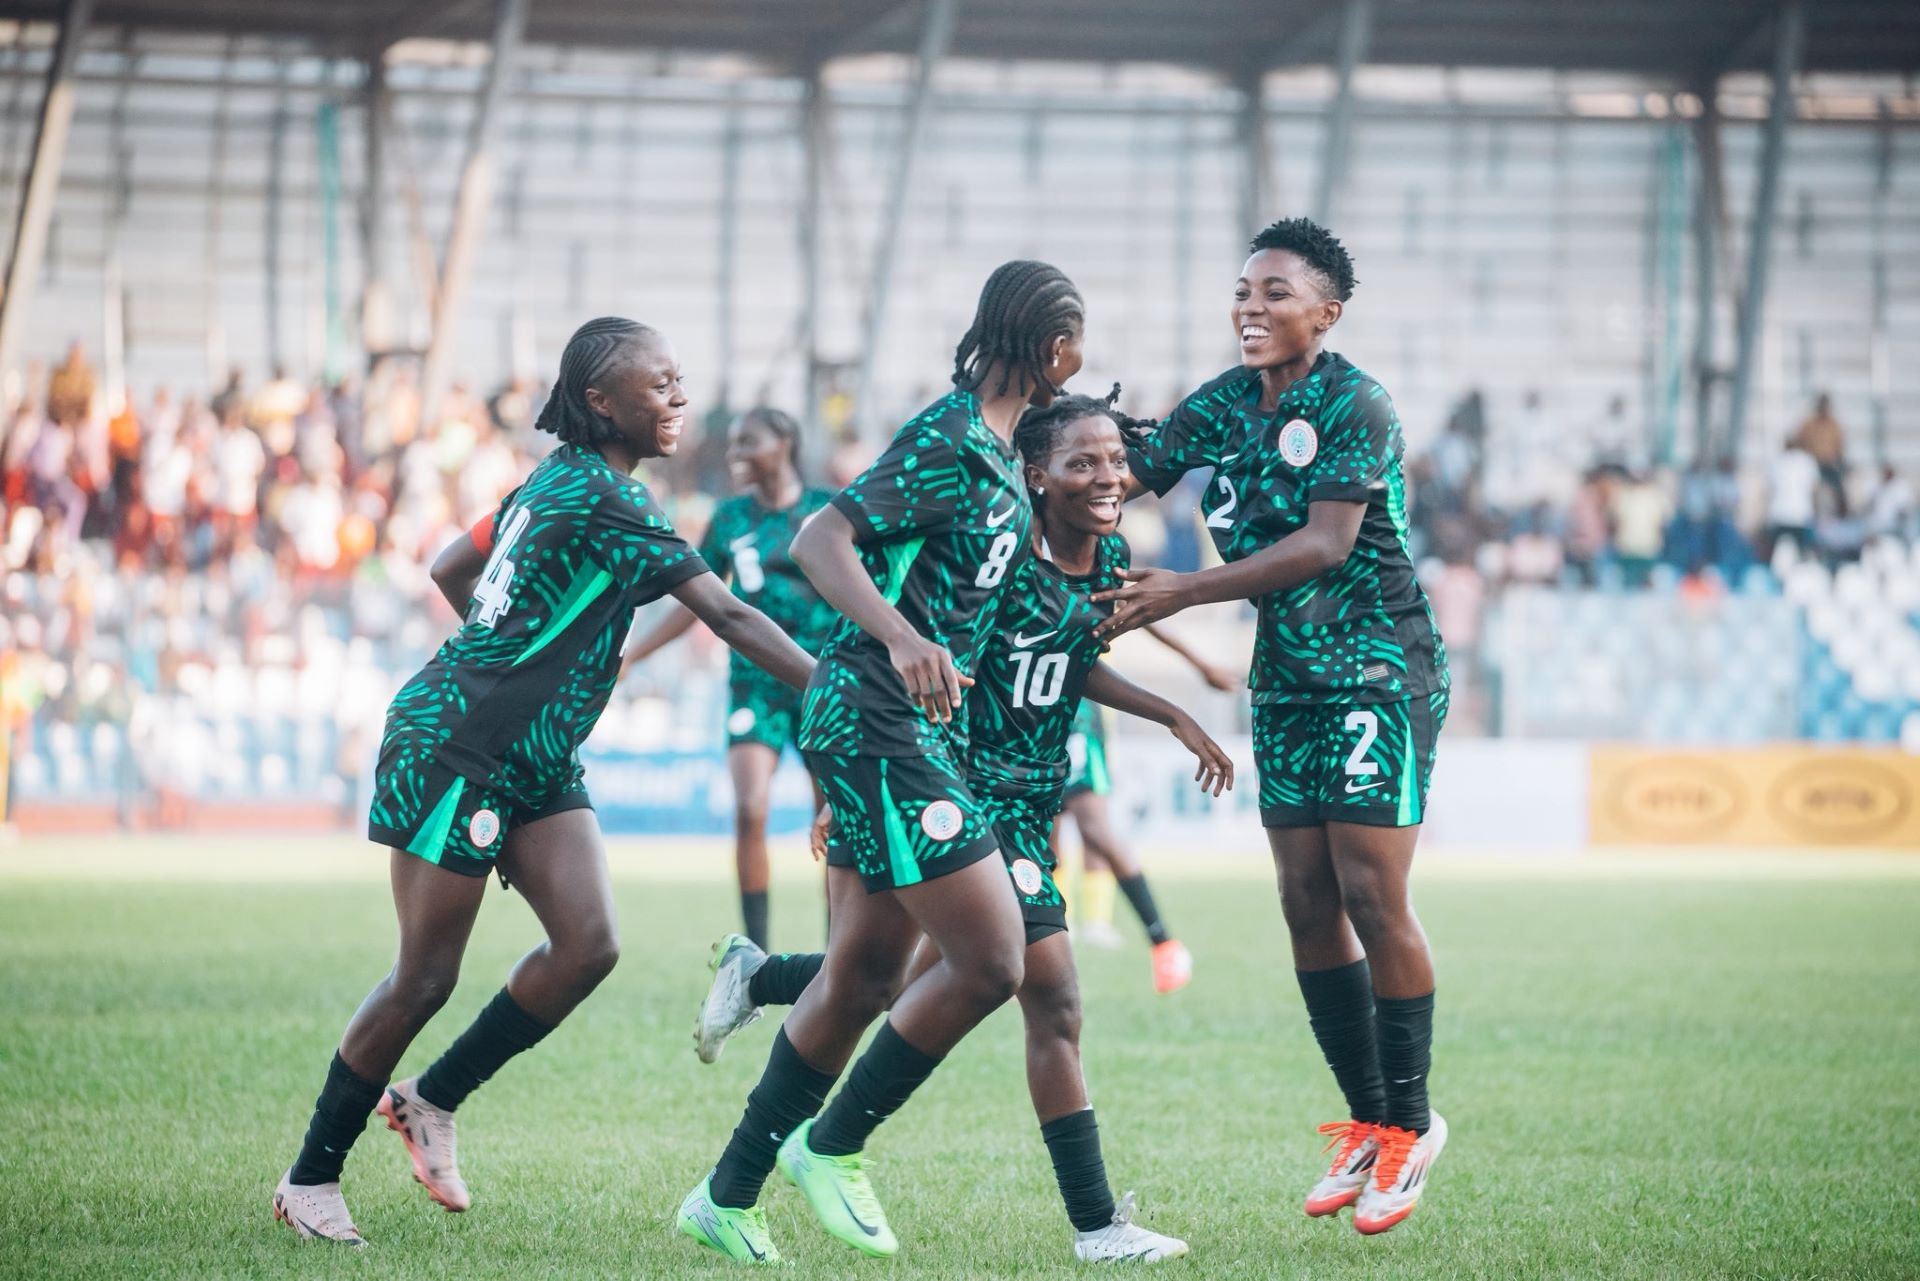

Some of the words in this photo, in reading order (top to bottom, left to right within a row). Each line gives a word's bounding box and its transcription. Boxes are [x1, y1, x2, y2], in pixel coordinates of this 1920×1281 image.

[1206, 475, 1237, 529] 2
[472, 503, 531, 629] 4
[975, 532, 1018, 589] 8
[1008, 651, 1070, 708] 10
[1344, 711, 1379, 775] 2
